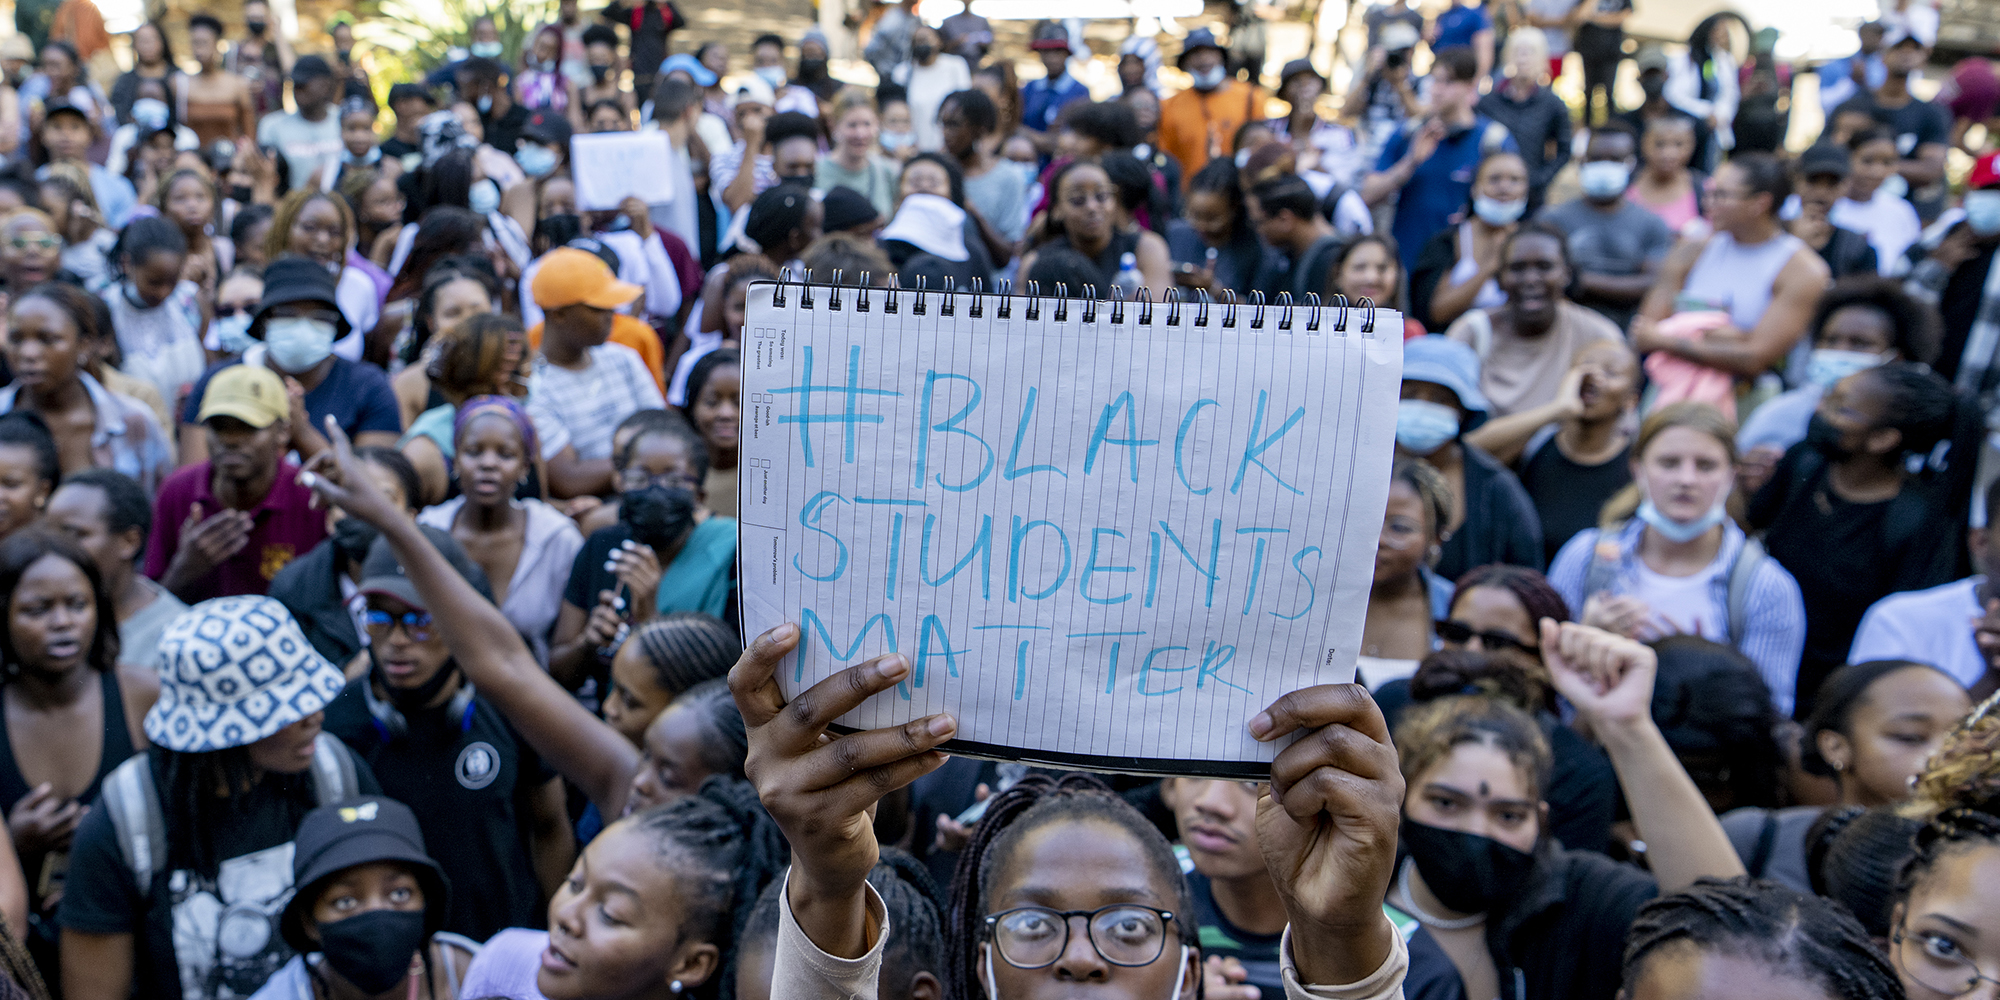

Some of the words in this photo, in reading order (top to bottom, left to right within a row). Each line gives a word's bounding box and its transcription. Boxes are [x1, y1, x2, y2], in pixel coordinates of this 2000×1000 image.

[766, 344, 1307, 496] #BLACK
[792, 490, 1324, 620] STUDENTS
[794, 607, 1255, 701] MATTER
[1325, 648, 1335, 666] Date:
